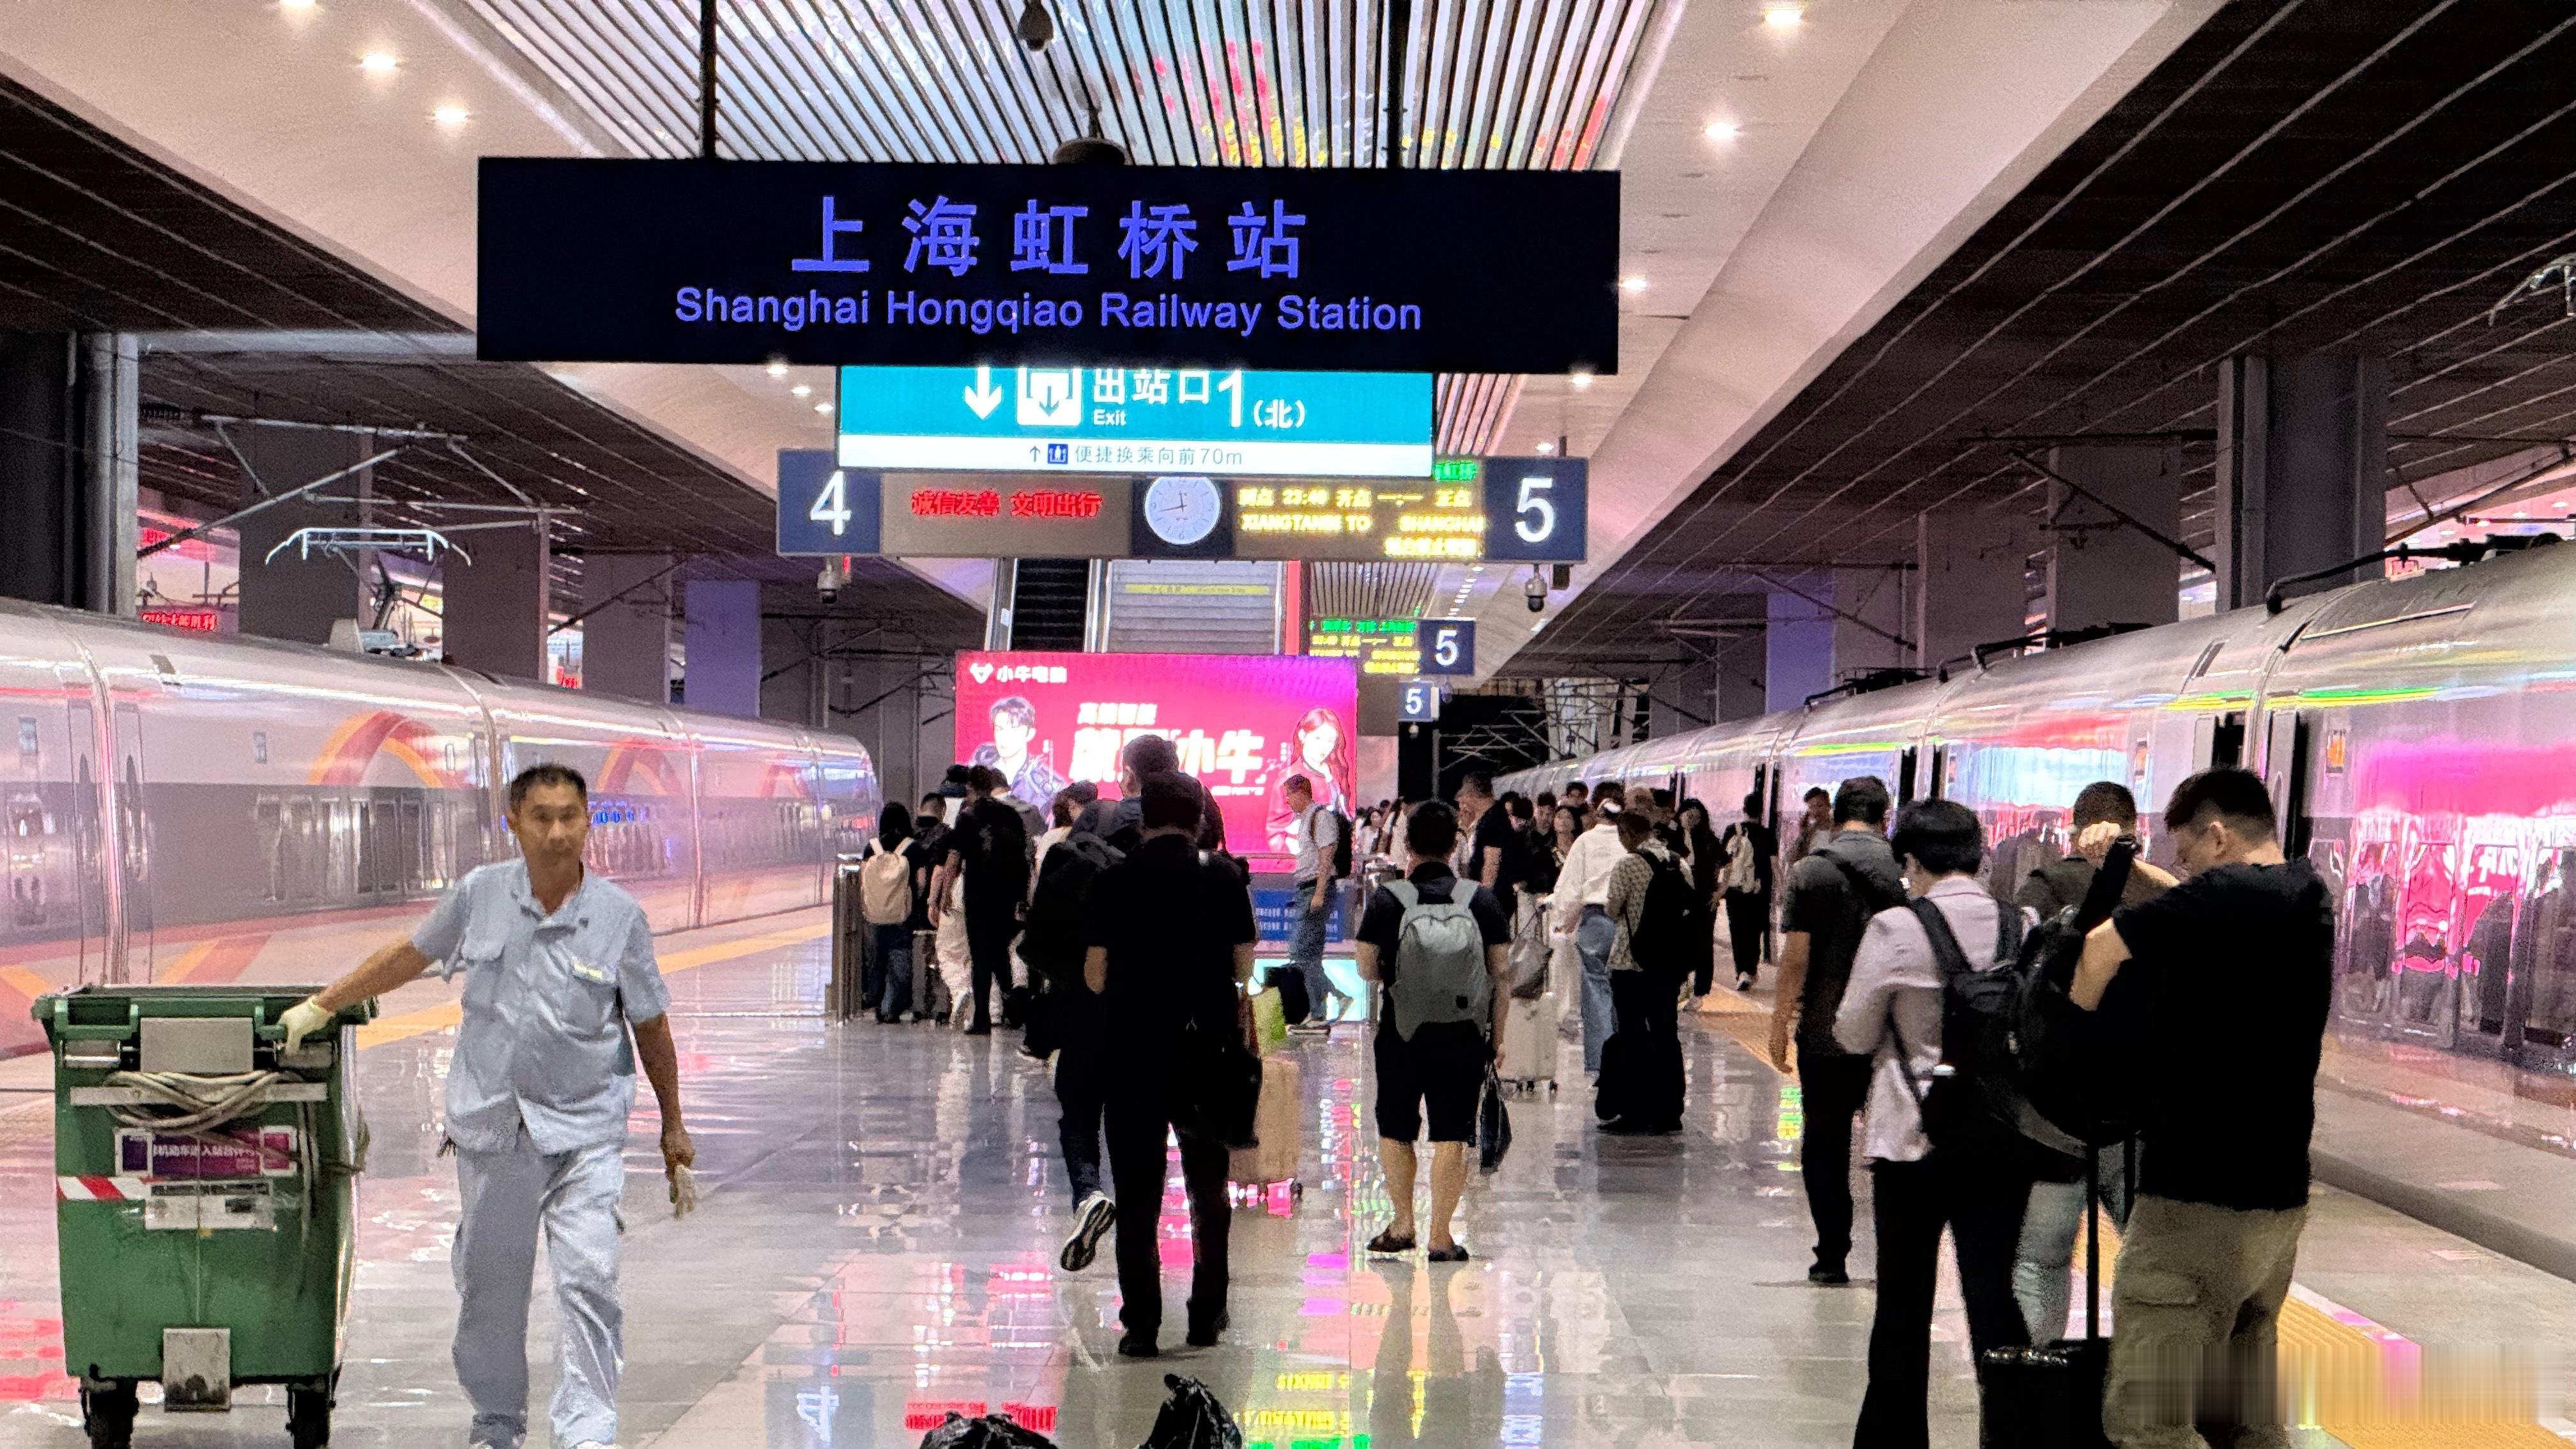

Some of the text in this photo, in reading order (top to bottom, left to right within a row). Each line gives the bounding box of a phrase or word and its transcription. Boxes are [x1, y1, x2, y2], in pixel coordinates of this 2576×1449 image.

[792, 195, 1307, 280] 上海虹桥站
[676, 288, 1422, 337] Shanghai Hongqiao Railway Station
[1094, 410, 1126, 426] Exit
[1075, 445, 1243, 466] 便捷换乘向前70m
[810, 470, 852, 536] 4
[911, 491, 1103, 517] 诚信友善 文明出行
[1515, 478, 1555, 543] 5
[1345, 515, 1372, 532] TO
[1435, 630, 1459, 666] 5
[1405, 687, 1424, 715] 5
